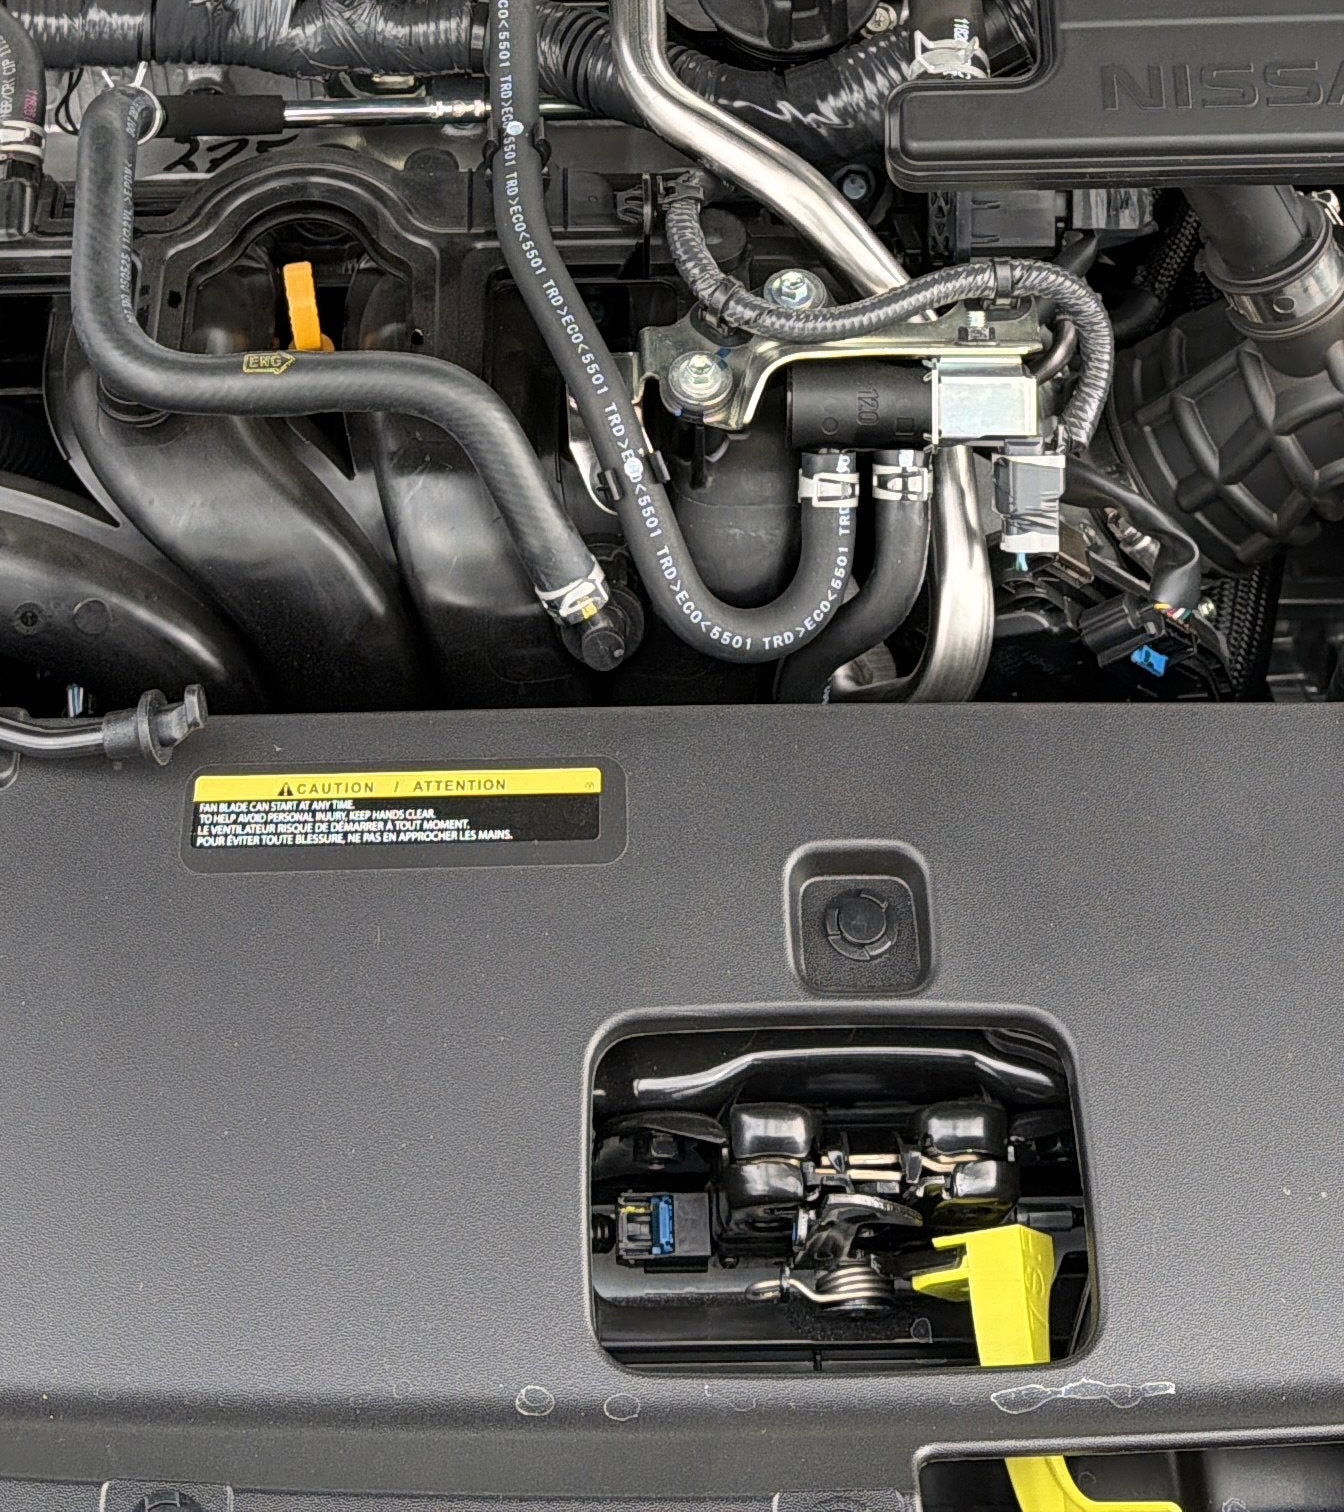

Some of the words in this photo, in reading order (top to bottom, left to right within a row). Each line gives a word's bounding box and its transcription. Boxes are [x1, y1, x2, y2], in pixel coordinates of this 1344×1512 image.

[248, 355, 282, 368] ENG
[297, 781, 374, 795] CAUTION
[413, 779, 506, 792] ATTENTION
[199, 803, 218, 813] FAN
[219, 802, 248, 812] BLADE
[249, 801, 270, 811] CAN
[271, 801, 297, 811] START
[298, 800, 310, 810] AT
[312, 800, 332, 810] ANY
[332, 799, 355, 809] TIME.
[199, 814, 212, 824] TO
[213, 813, 237, 823] HELP
[237, 813, 267, 823] AVOID
[267, 812, 314, 822] PERSONAL
[349, 810, 372, 820] KEEP
[372, 809, 405, 819] HANDS
[406, 809, 436, 819] CLEAR.
[197, 825, 209, 835] LE
[210, 824, 276, 835] VENTILATEUR
[277, 823, 314, 834] RISQUE
[314, 822, 329, 832] DE
[395, 820, 422, 830] TOUT
[423, 819, 470, 829] MOMENT.
[196, 836, 226, 846] POUR
[261, 835, 294, 845] TOUTE
[347, 832, 362, 843] NE
[363, 832, 382, 842] PAS
[383, 831, 397, 842] EN
[398, 830, 458, 841] APPROCHER
[459, 830, 477, 840] LES
[478, 829, 514, 840] MAINS.
